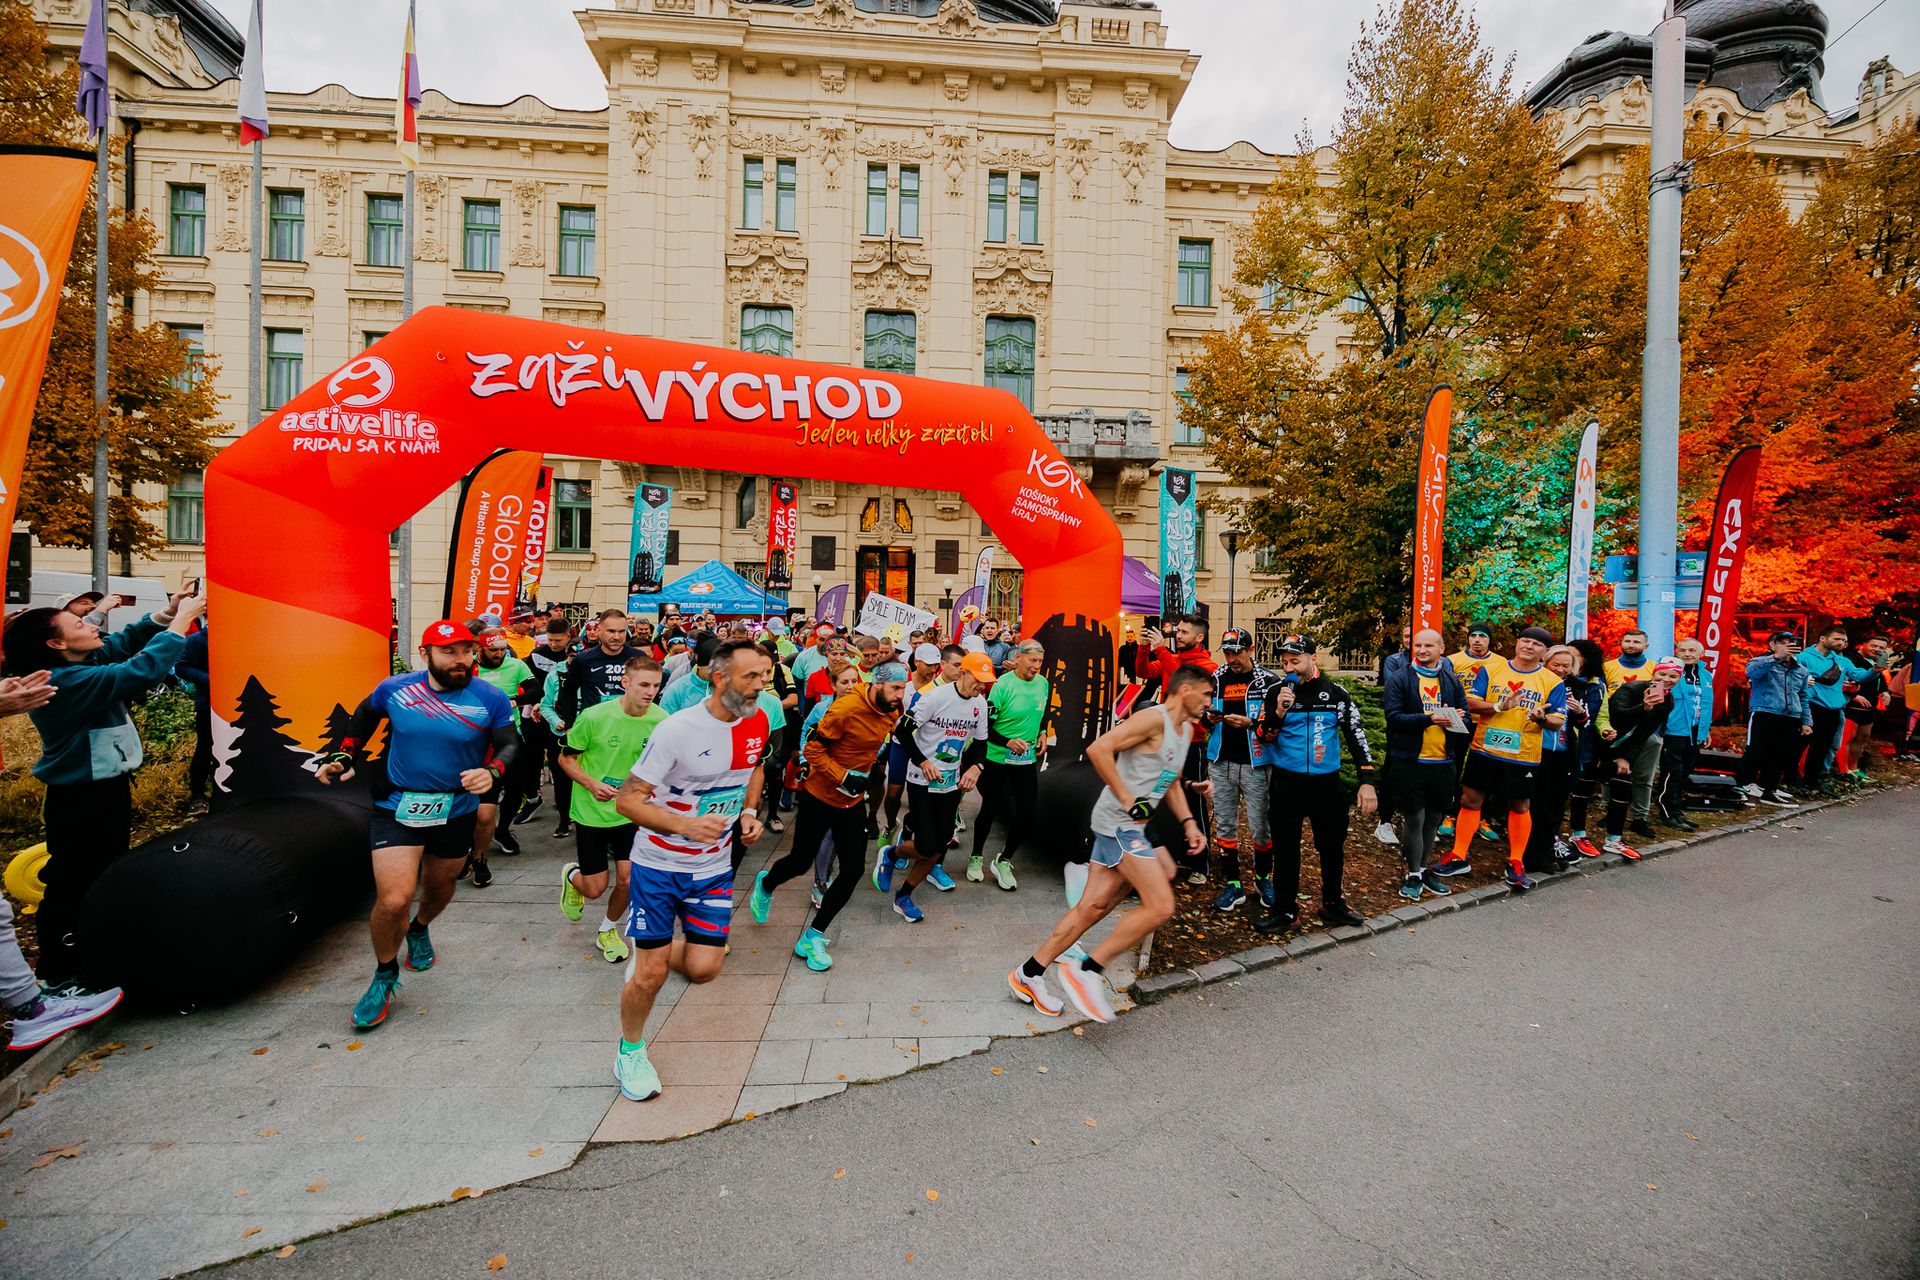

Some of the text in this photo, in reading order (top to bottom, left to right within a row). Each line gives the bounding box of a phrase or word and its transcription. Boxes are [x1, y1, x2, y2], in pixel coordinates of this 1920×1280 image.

[624, 361, 903, 421] VÝCHOD
[279, 405, 438, 441] activelife
[795, 418, 860, 447] Jeden
[293, 437, 352, 453] PRIDAJ
[356, 438, 380, 455] SA
[384, 440, 396, 454] K
[1026, 448, 1084, 500] KSK
[1019, 486, 1059, 507] KOŠICKÝ
[1011, 506, 1037, 523] KRAJ
[1014, 496, 1082, 528] SAMOSPRÁVNY
[465, 491, 491, 613] A Hitachi Group Company
[1704, 499, 1742, 679] EXISPOR
[867, 597, 890, 618] SMILE
[894, 606, 916, 627] TEAM
[1491, 734, 1513, 745] 3/2
[407, 802, 444, 816] 37/1
